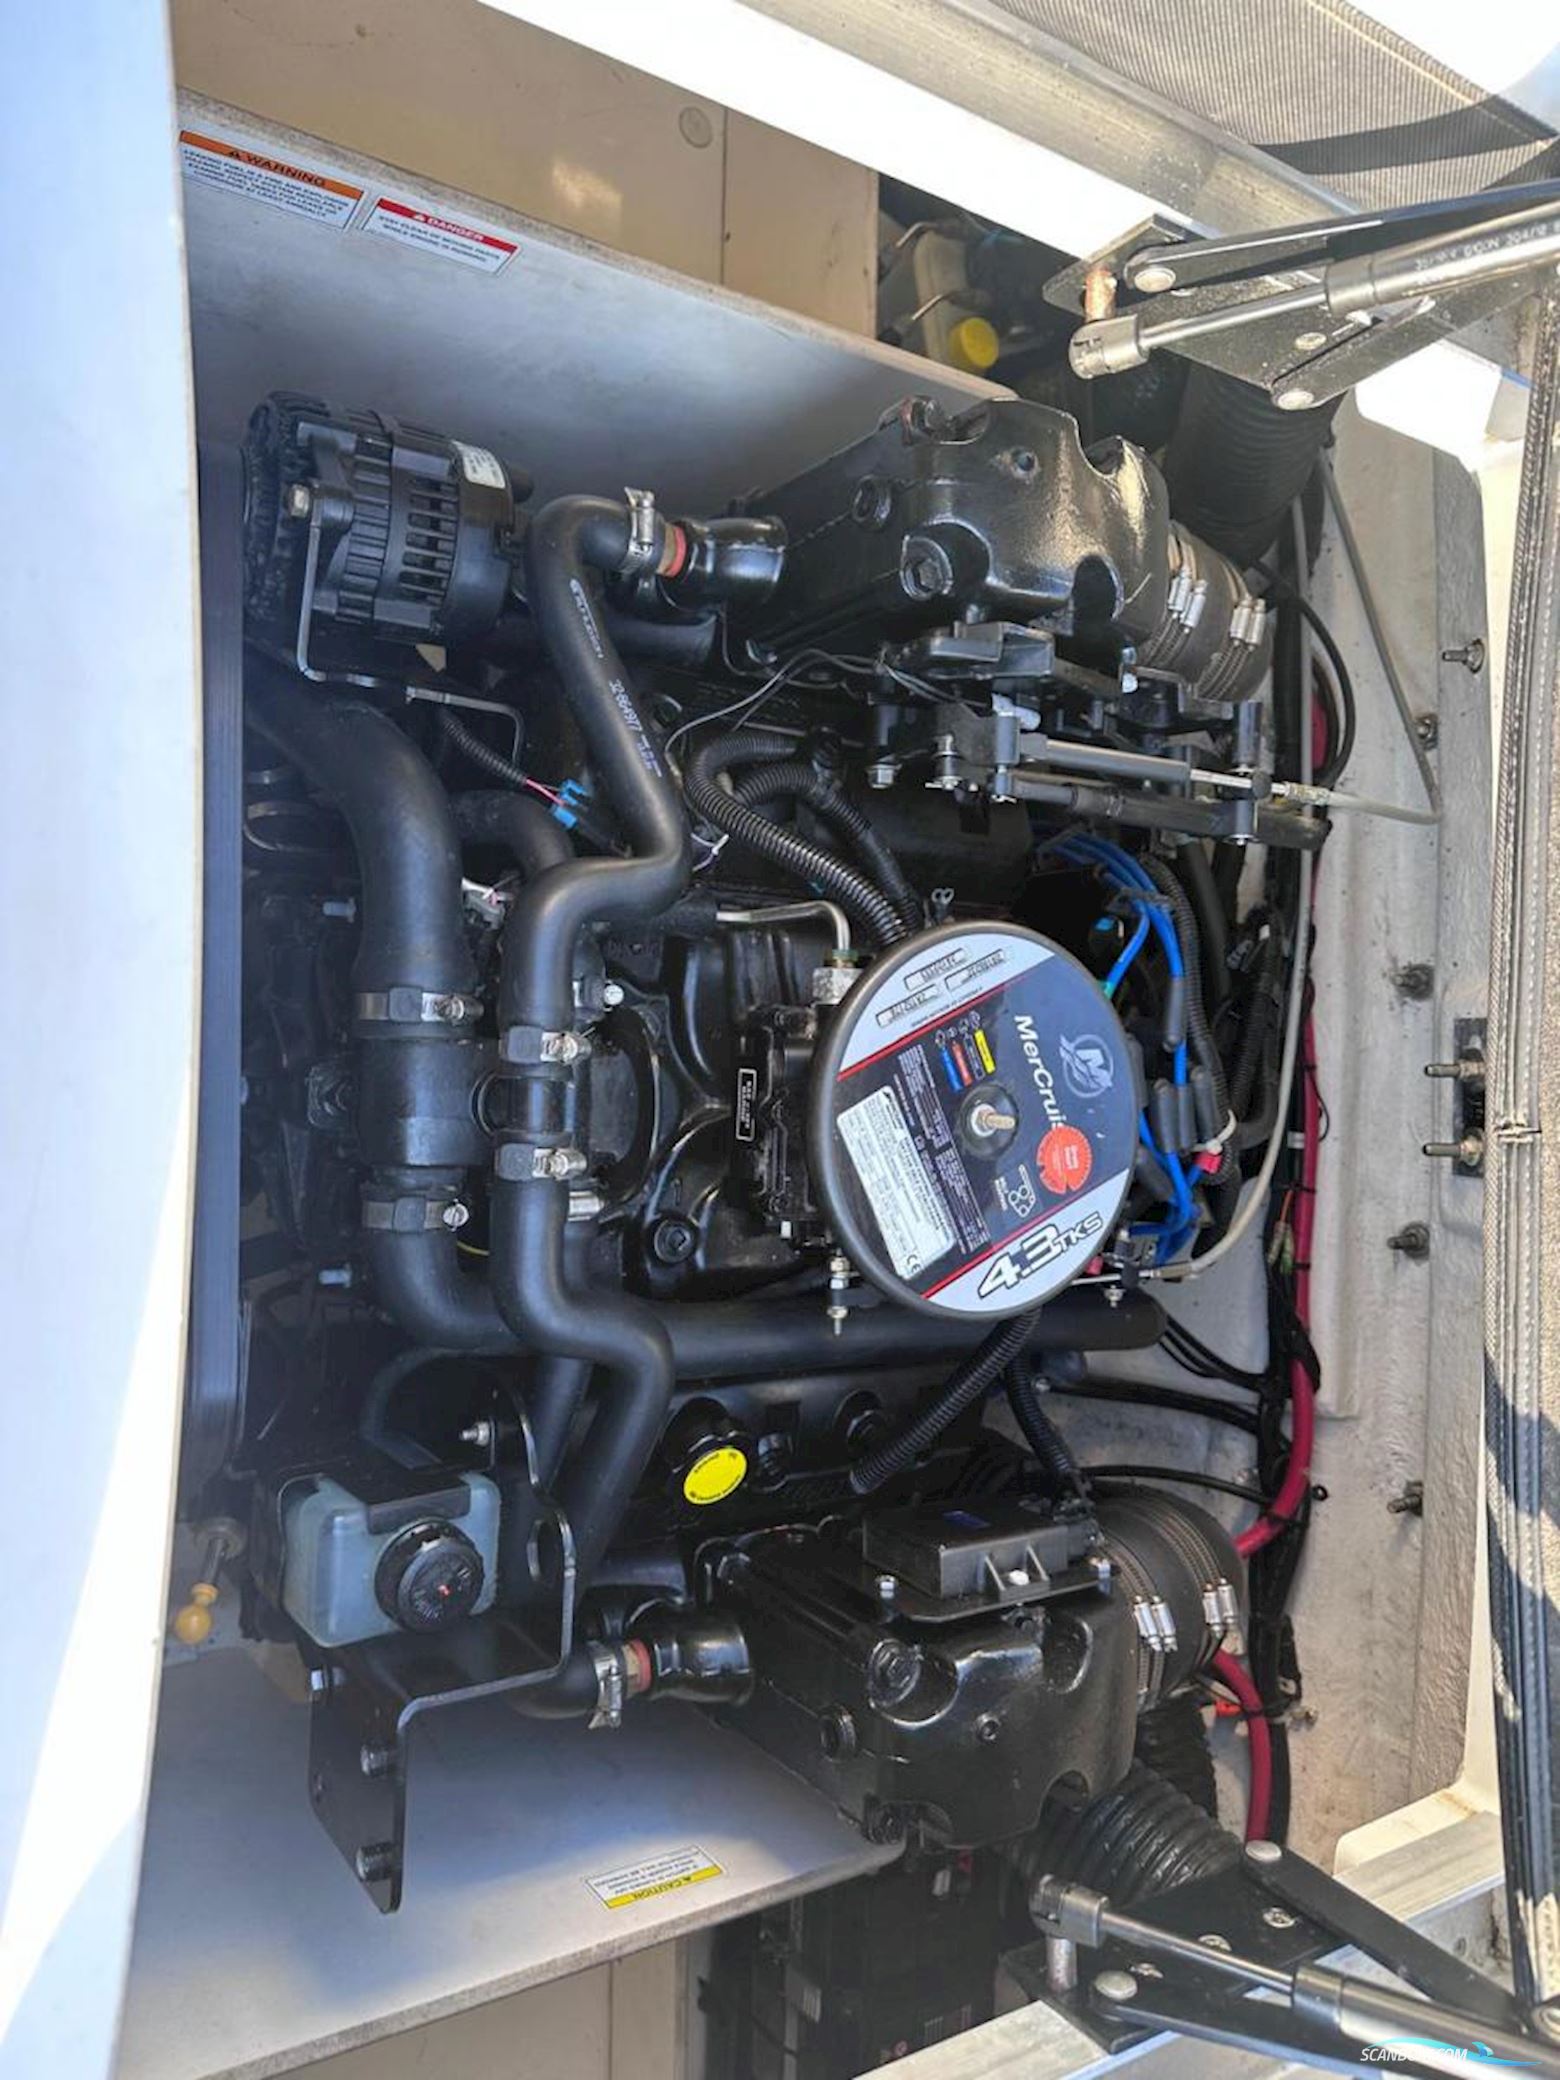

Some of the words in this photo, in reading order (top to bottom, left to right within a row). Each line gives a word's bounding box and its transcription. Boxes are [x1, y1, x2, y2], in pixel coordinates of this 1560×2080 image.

[246, 154, 326, 187] WARNING
[427, 217, 484, 242] DANGER
[632, 1879, 682, 1899] CAUTION
